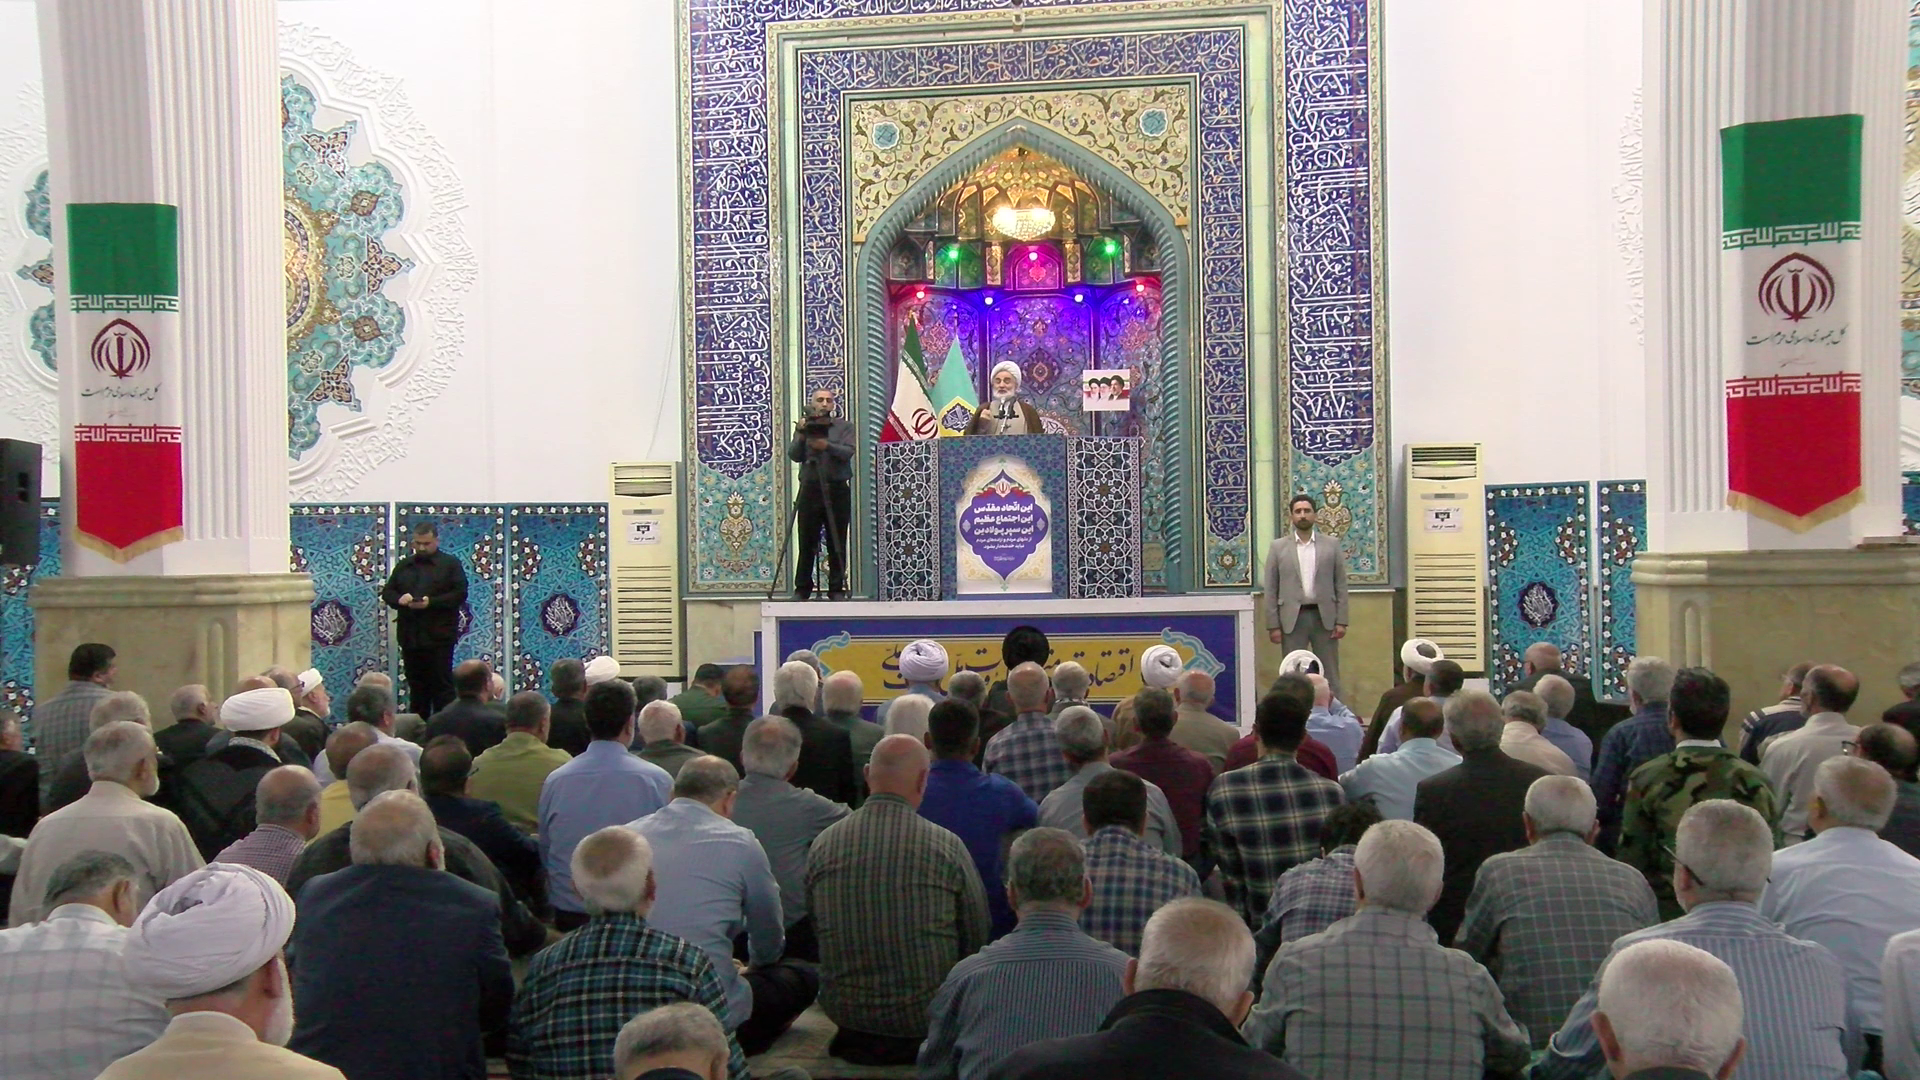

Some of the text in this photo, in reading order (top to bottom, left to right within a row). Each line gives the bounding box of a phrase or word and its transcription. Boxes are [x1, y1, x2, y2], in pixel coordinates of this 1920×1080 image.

[1020, 504, 1033, 513] این
[974, 515, 1033, 524] این اجتماع عظیم
[974, 525, 1034, 536] این سپر پولادین
[1089, 647, 1134, 687] اقتصاد
